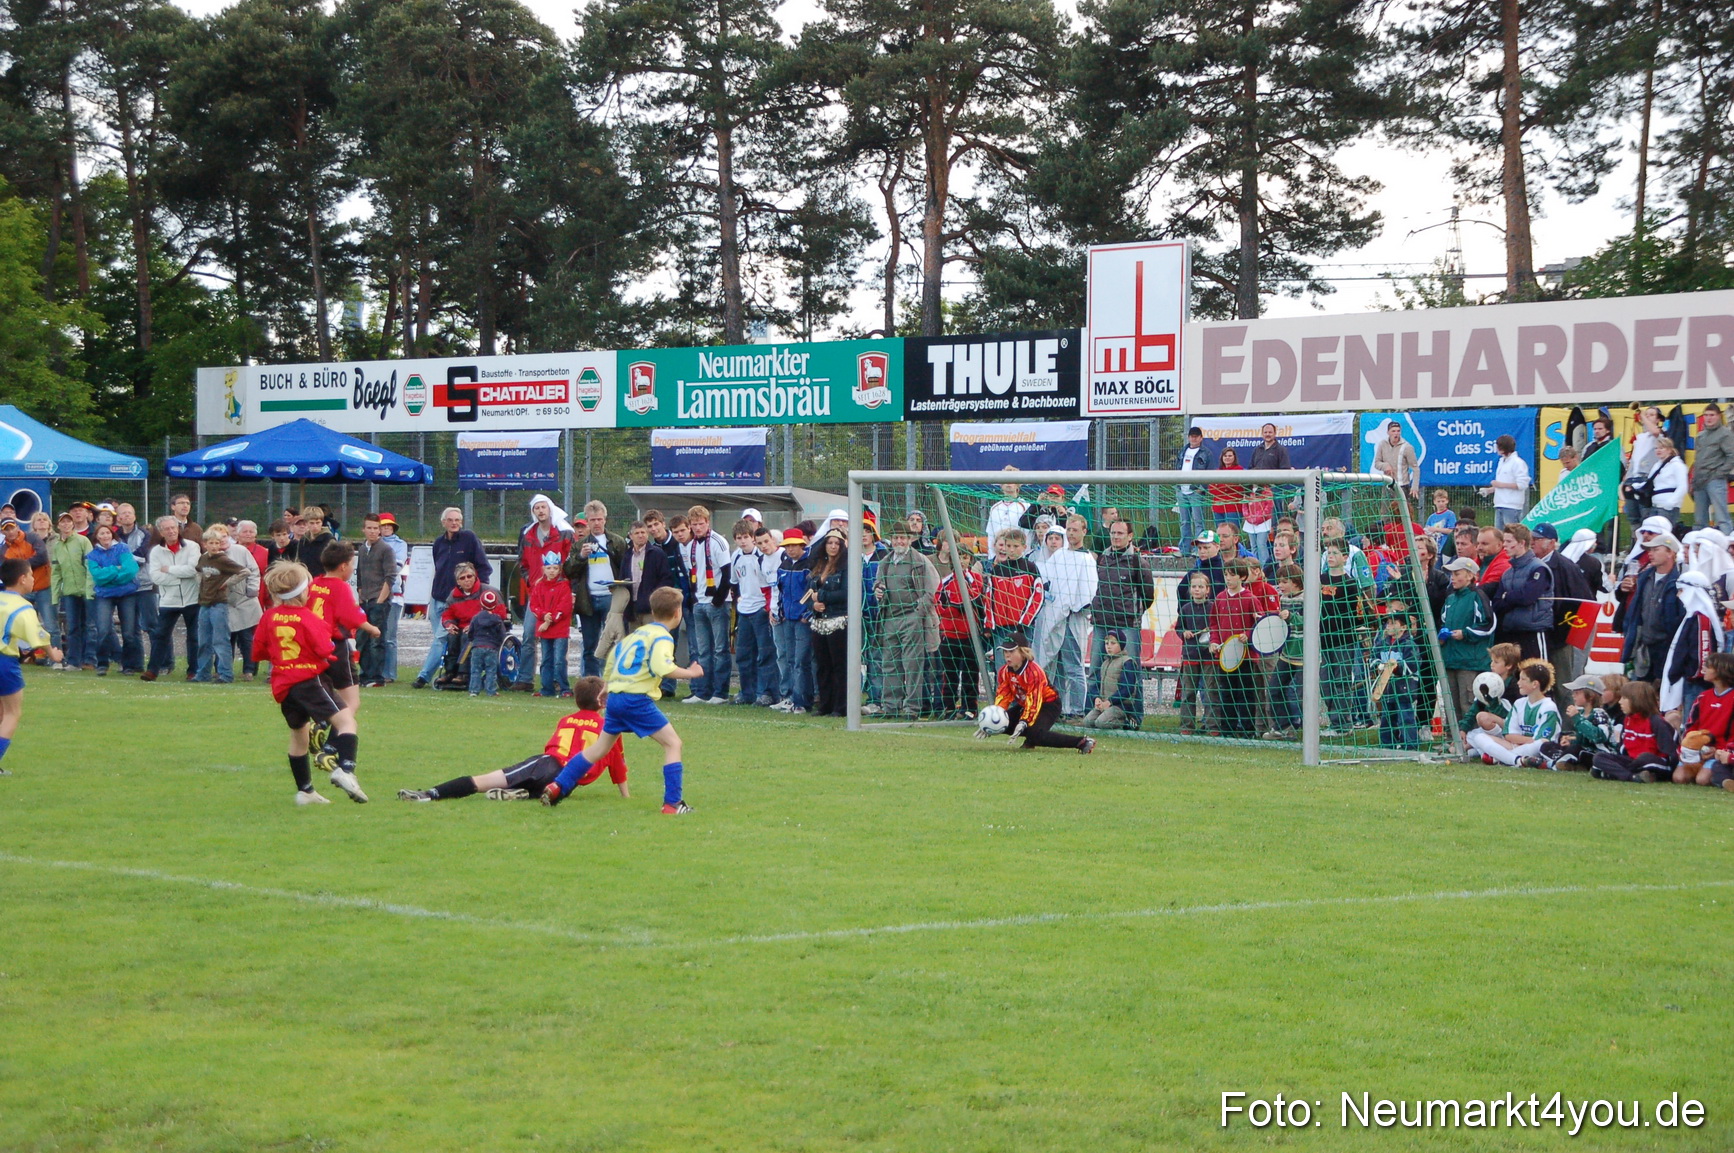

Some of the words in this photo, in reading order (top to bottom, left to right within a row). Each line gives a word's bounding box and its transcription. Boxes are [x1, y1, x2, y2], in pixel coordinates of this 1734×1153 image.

[699, 347, 810, 379] Neumarkter
[927, 338, 1059, 395] THULE
[1201, 315, 1734, 406] EDENHARDER
[260, 372, 293, 390] BUCH
[299, 372, 308, 389] &
[313, 367, 347, 388] BÜRO
[481, 370, 513, 379] Baustoffe
[518, 368, 570, 379] Transportbeton
[1021, 378, 1053, 387] SWEDEN
[1094, 381, 1129, 396] MAX
[1134, 376, 1175, 394] BÖGL
[677, 378, 831, 419] Lammsbräu
[910, 398, 1009, 412] Lastenträgersysteme
[1012, 398, 1020, 408] &
[1021, 396, 1076, 408] Dachboxen
[1093, 396, 1175, 406] BAUUNTERNEHMUNG
[542, 407, 552, 415] 69
[553, 407, 570, 415] 50-0
[1437, 420, 1485, 437] Schön,
[459, 439, 520, 451] Programmvielfalt
[655, 436, 723, 448] Programmvielfalt
[953, 432, 1036, 446] Programmvielfalt
[675, 447, 704, 456] gebührend
[979, 444, 1013, 453] gebührend
[1014, 443, 1047, 453] genießen!
[1455, 441, 1481, 455] dass
[1485, 440, 1498, 454] Si
[1434, 459, 1461, 475] hier
[1464, 460, 1493, 474] sind!
[273, 613, 302, 623] Angola
[276, 625, 301, 661] 3
[566, 716, 599, 728] Angola
